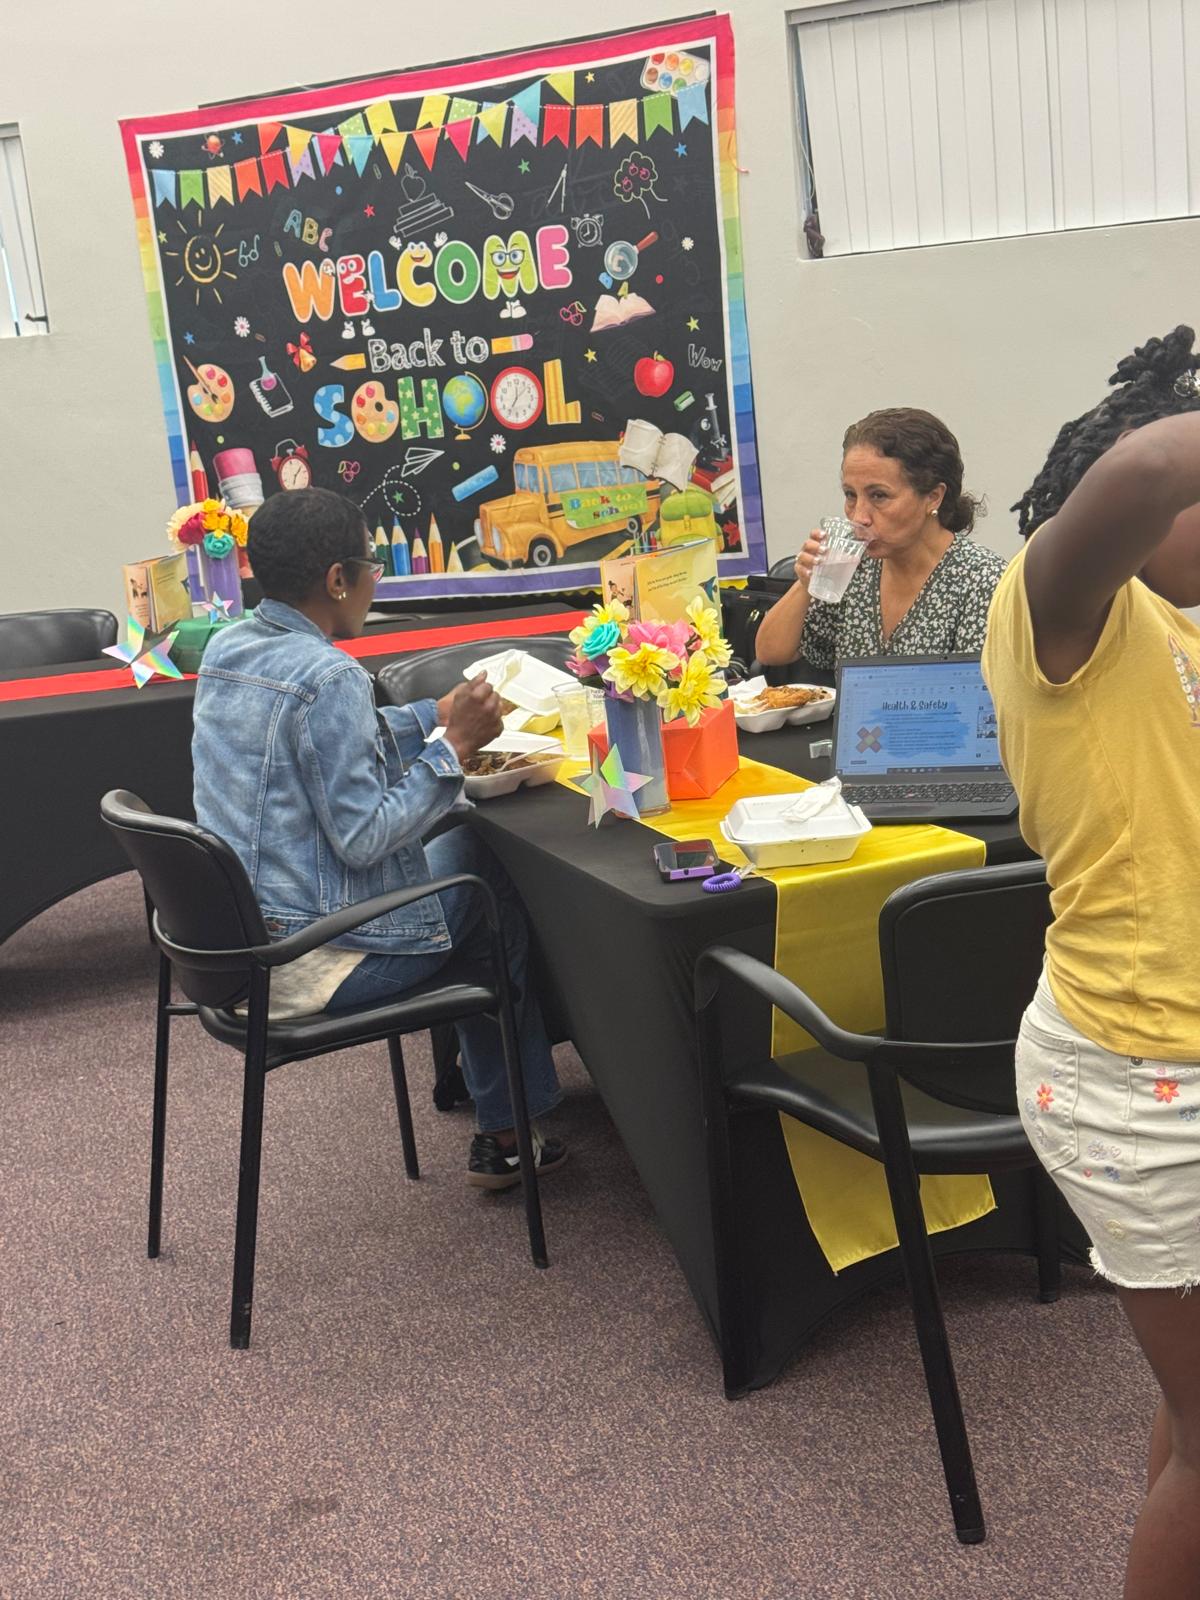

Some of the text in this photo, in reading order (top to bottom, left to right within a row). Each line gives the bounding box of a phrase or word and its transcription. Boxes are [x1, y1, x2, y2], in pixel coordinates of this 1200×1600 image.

[283, 209, 333, 252] ABC
[282, 224, 573, 324] WELCOME
[367, 328, 490, 373] Back to
[313, 358, 582, 448] SCHOOL
[882, 699, 948, 711] Health & Safety
